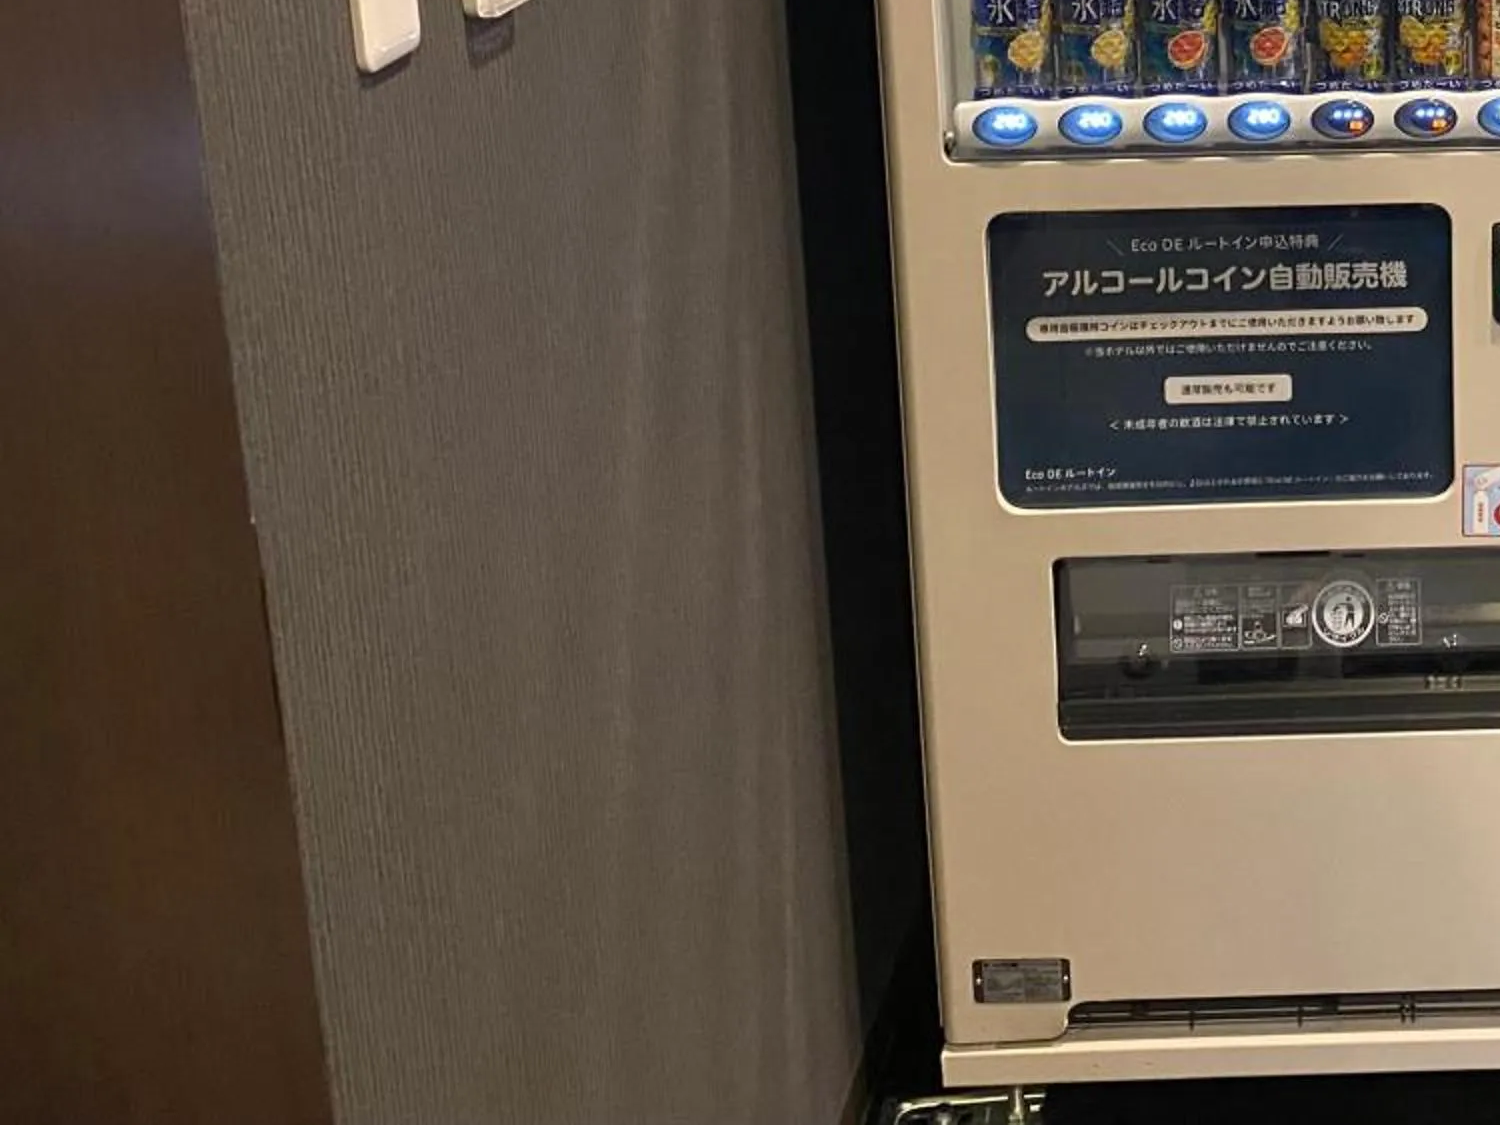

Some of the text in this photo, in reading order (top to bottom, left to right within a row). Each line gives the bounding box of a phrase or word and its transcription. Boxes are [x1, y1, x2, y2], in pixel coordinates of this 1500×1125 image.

[1131, 238, 1156, 252] Eco
[1161, 237, 1183, 251] DE
[1042, 260, 1408, 298] アルコールコイン自動販売機
[1025, 468, 1044, 480] Eco
[1047, 468, 1061, 480] DE
